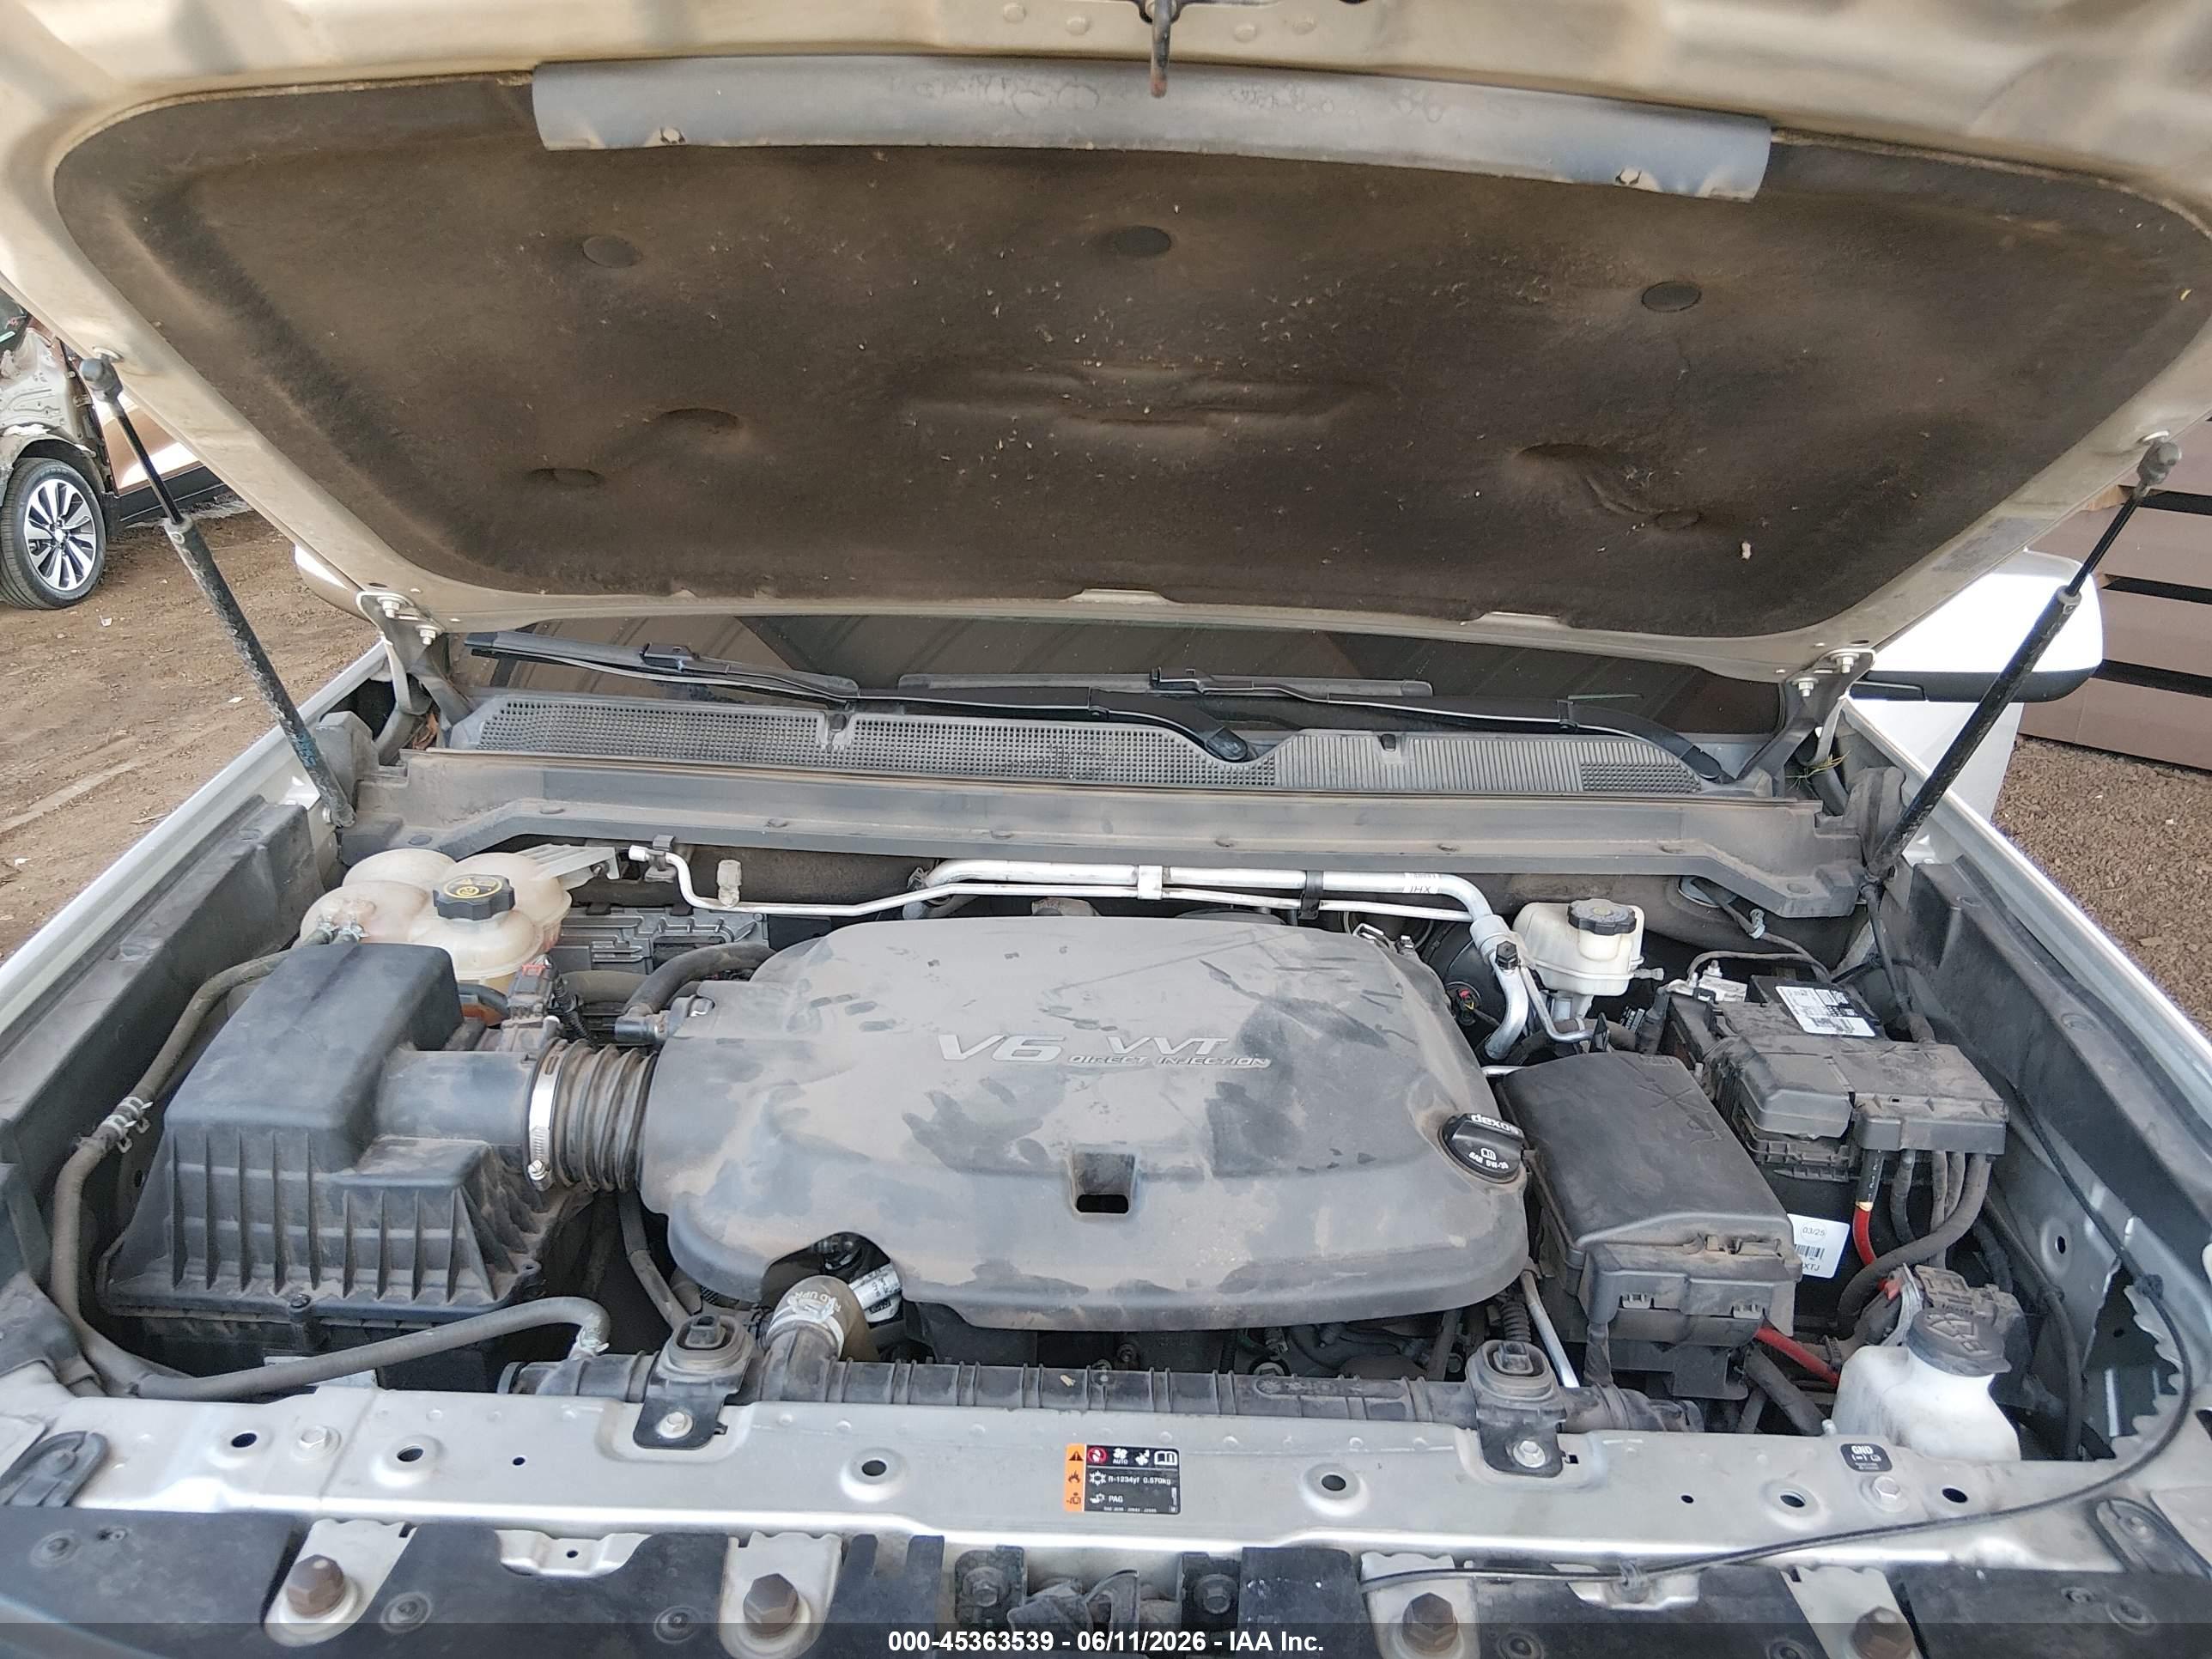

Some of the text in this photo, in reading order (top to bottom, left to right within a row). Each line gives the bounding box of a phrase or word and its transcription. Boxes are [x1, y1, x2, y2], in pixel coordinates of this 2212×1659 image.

[938, 1033, 1229, 1062] V6 VVT
[1068, 1054, 1271, 1068] DIRECT INJECTION
[1851, 1445, 1874, 1455] GND
[1108, 1475, 1140, 1485] R-1234yf
[1109, 1495, 1124, 1504] PAG
